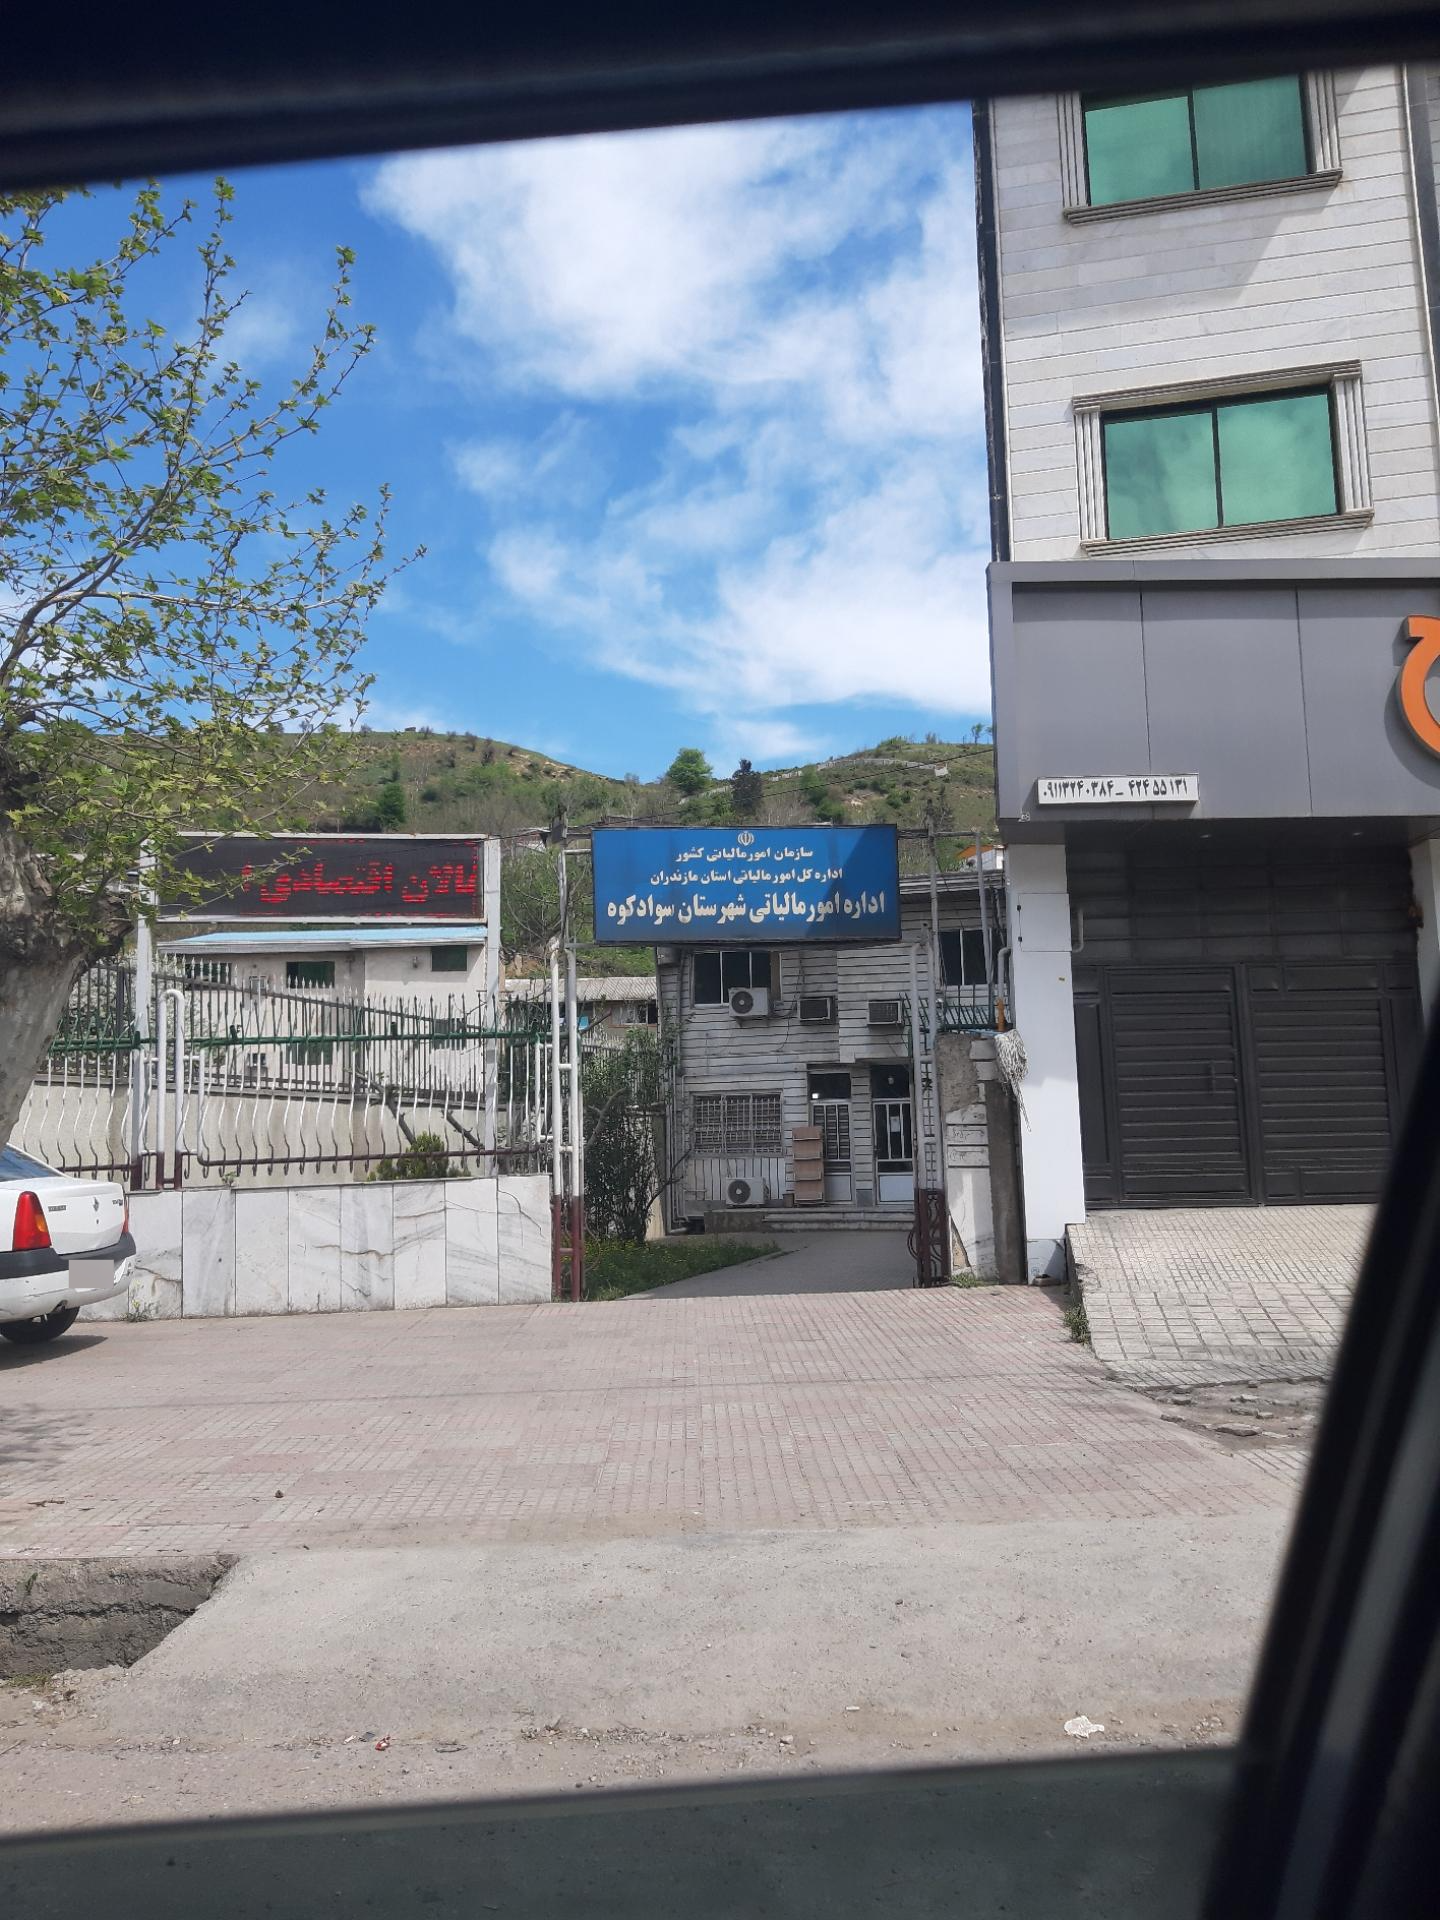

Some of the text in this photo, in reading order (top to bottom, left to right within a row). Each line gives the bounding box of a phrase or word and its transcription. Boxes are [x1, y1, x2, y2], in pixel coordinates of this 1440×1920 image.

[675, 846, 705, 863] کشور
[774, 846, 814, 862] سازمان
[650, 869, 699, 886] مازندران
[700, 869, 732, 885] استان
[796, 868, 813, 883] کل
[814, 868, 843, 883] اداره
[607, 894, 675, 926] سوادکوه
[677, 893, 747, 925] شهرستان
[843, 891, 885, 919] اداره
